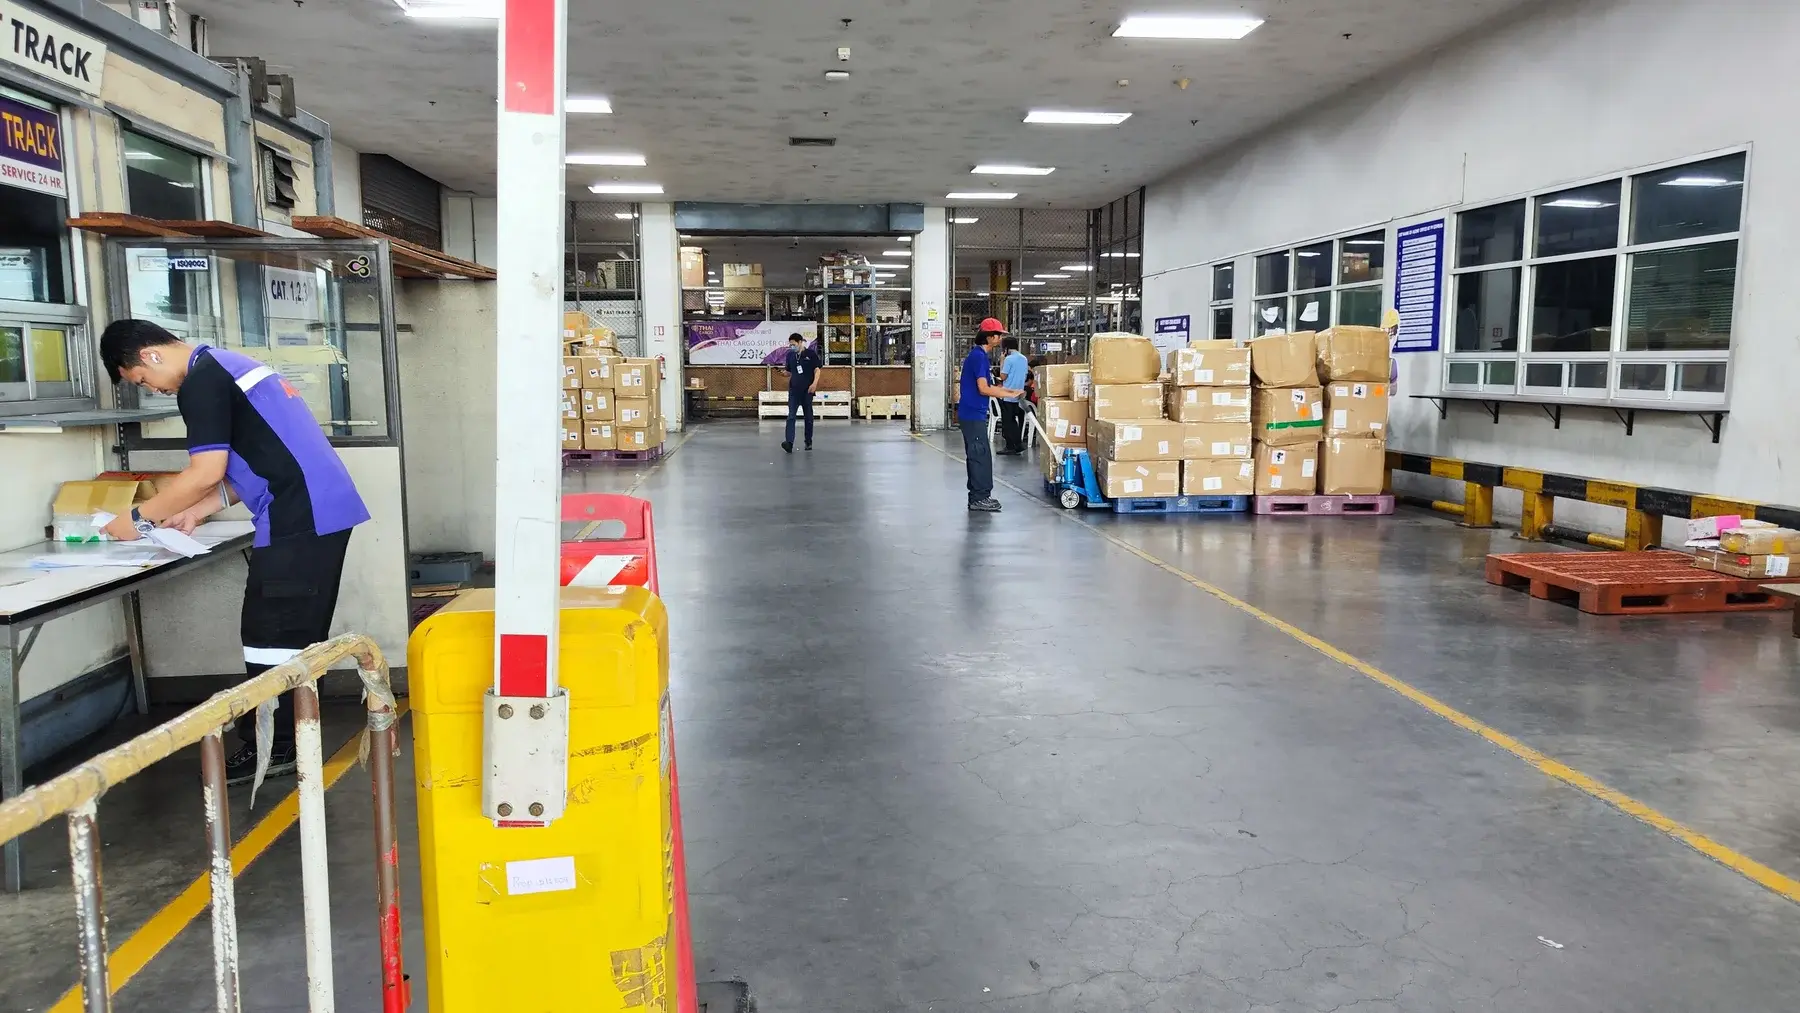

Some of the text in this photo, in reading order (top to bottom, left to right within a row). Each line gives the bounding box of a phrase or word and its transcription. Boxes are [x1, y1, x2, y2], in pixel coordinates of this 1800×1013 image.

[11, 17, 92, 82] TRACK
[2, 111, 59, 160] TRACK
[1, 164, 36, 183] SERVICE
[38, 173, 48, 185] 24
[271, 279, 289, 300] CAT.
[740, 349, 766, 360] 2016
